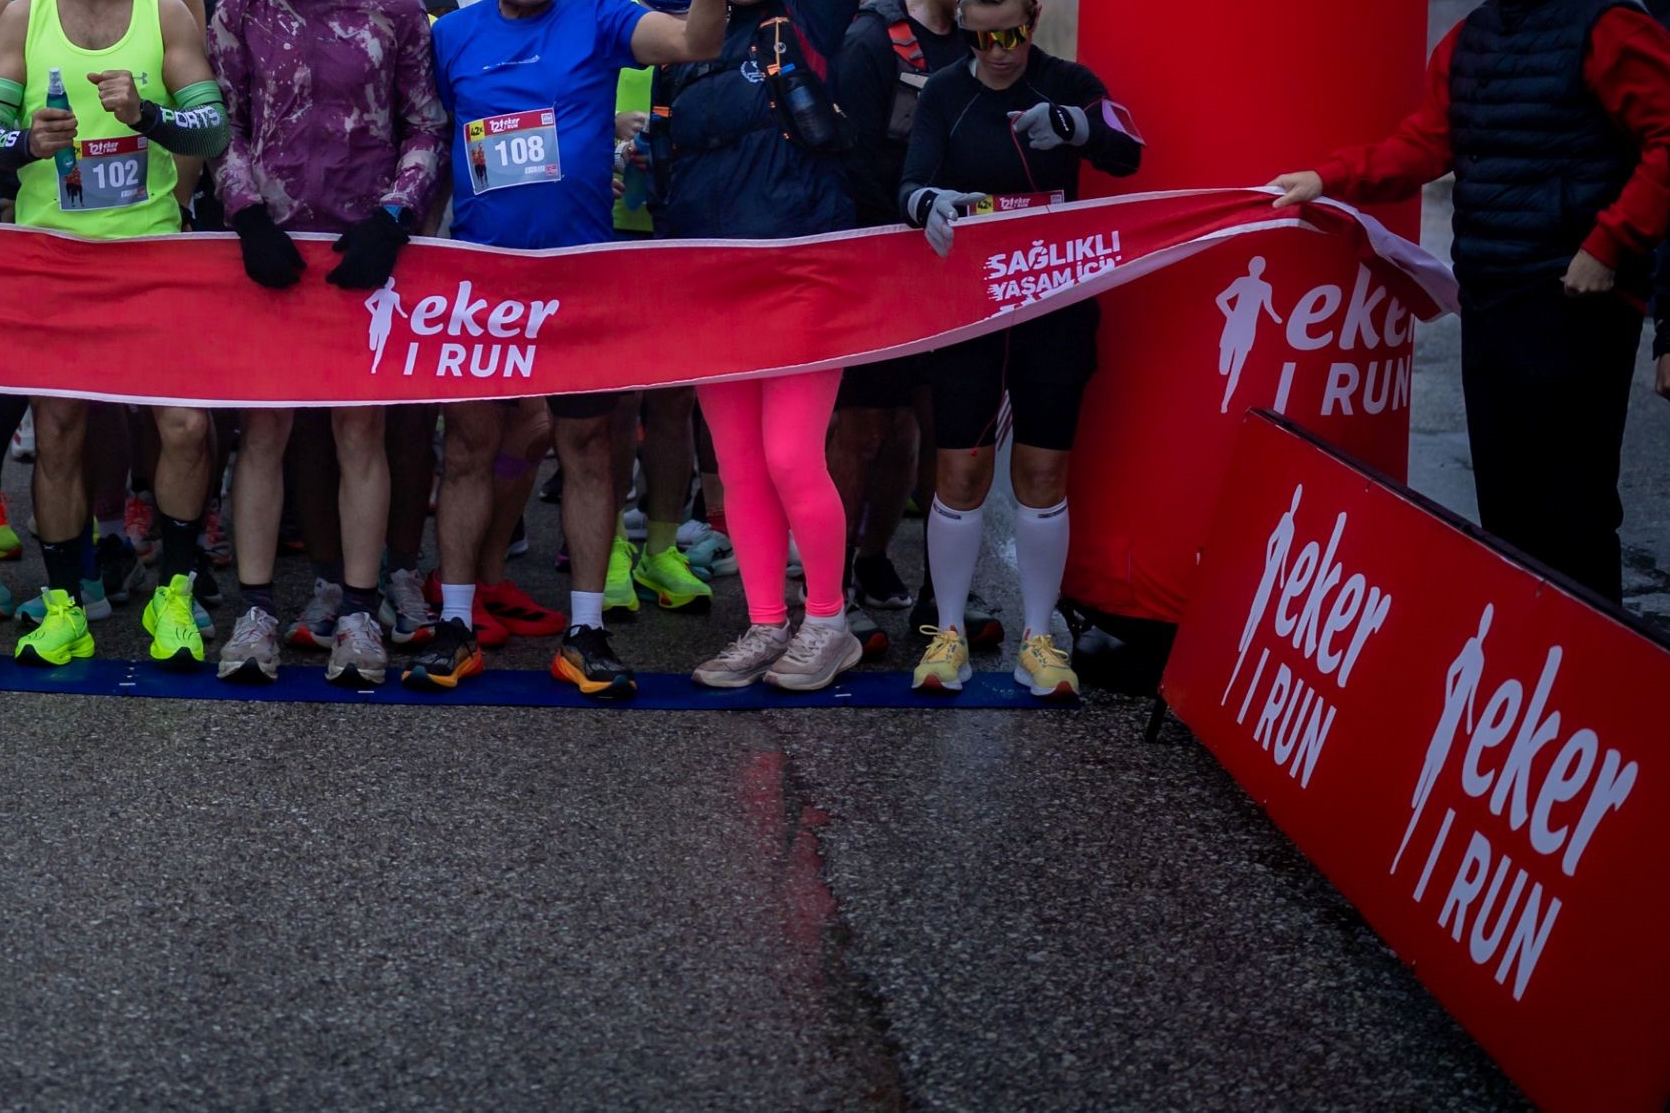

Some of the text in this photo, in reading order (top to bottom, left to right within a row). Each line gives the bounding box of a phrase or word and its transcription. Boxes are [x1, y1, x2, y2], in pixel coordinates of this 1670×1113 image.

[92, 159, 139, 189] 102
[495, 135, 545, 166] 108
[983, 230, 1121, 280] SAĞLIKLI
[410, 280, 559, 338] eker
[403, 342, 536, 377] I RUN
[1273, 355, 1411, 415] I RUN
[1274, 512, 1392, 688] eker
[1237, 647, 1337, 789] I RUN
[1461, 646, 1638, 876] eker
[1413, 808, 1562, 1001] I RUN
